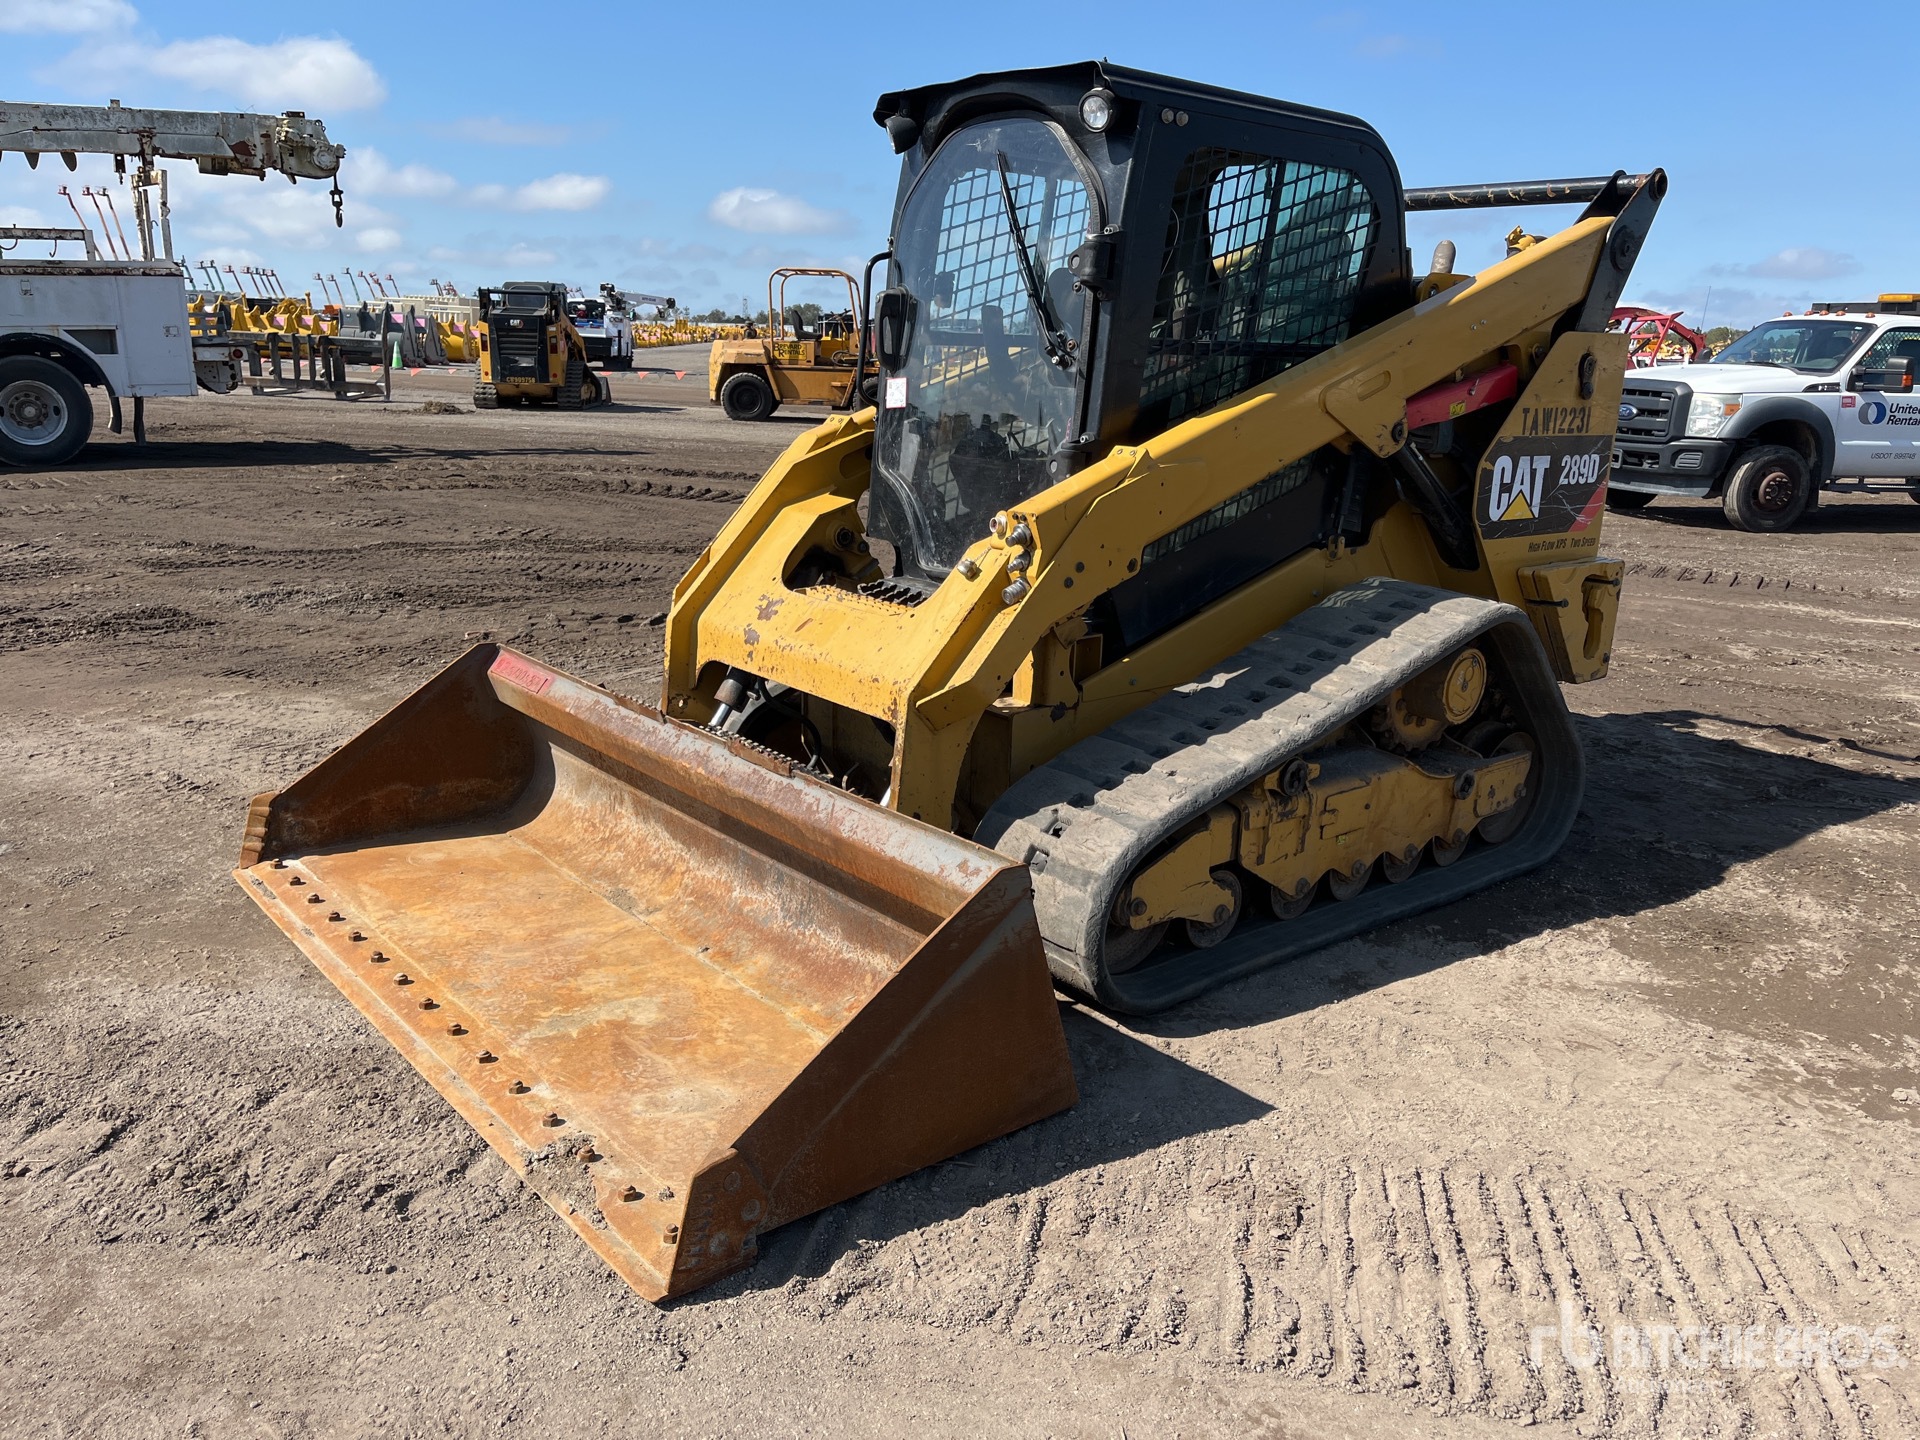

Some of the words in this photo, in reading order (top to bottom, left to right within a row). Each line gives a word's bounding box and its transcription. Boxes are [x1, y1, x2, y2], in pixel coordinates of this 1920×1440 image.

[774, 343, 802, 351] BREVARD
[1889, 402, 1920, 415] Unite
[1489, 455, 1551, 522] CAT
[1559, 453, 1600, 485] 289D
